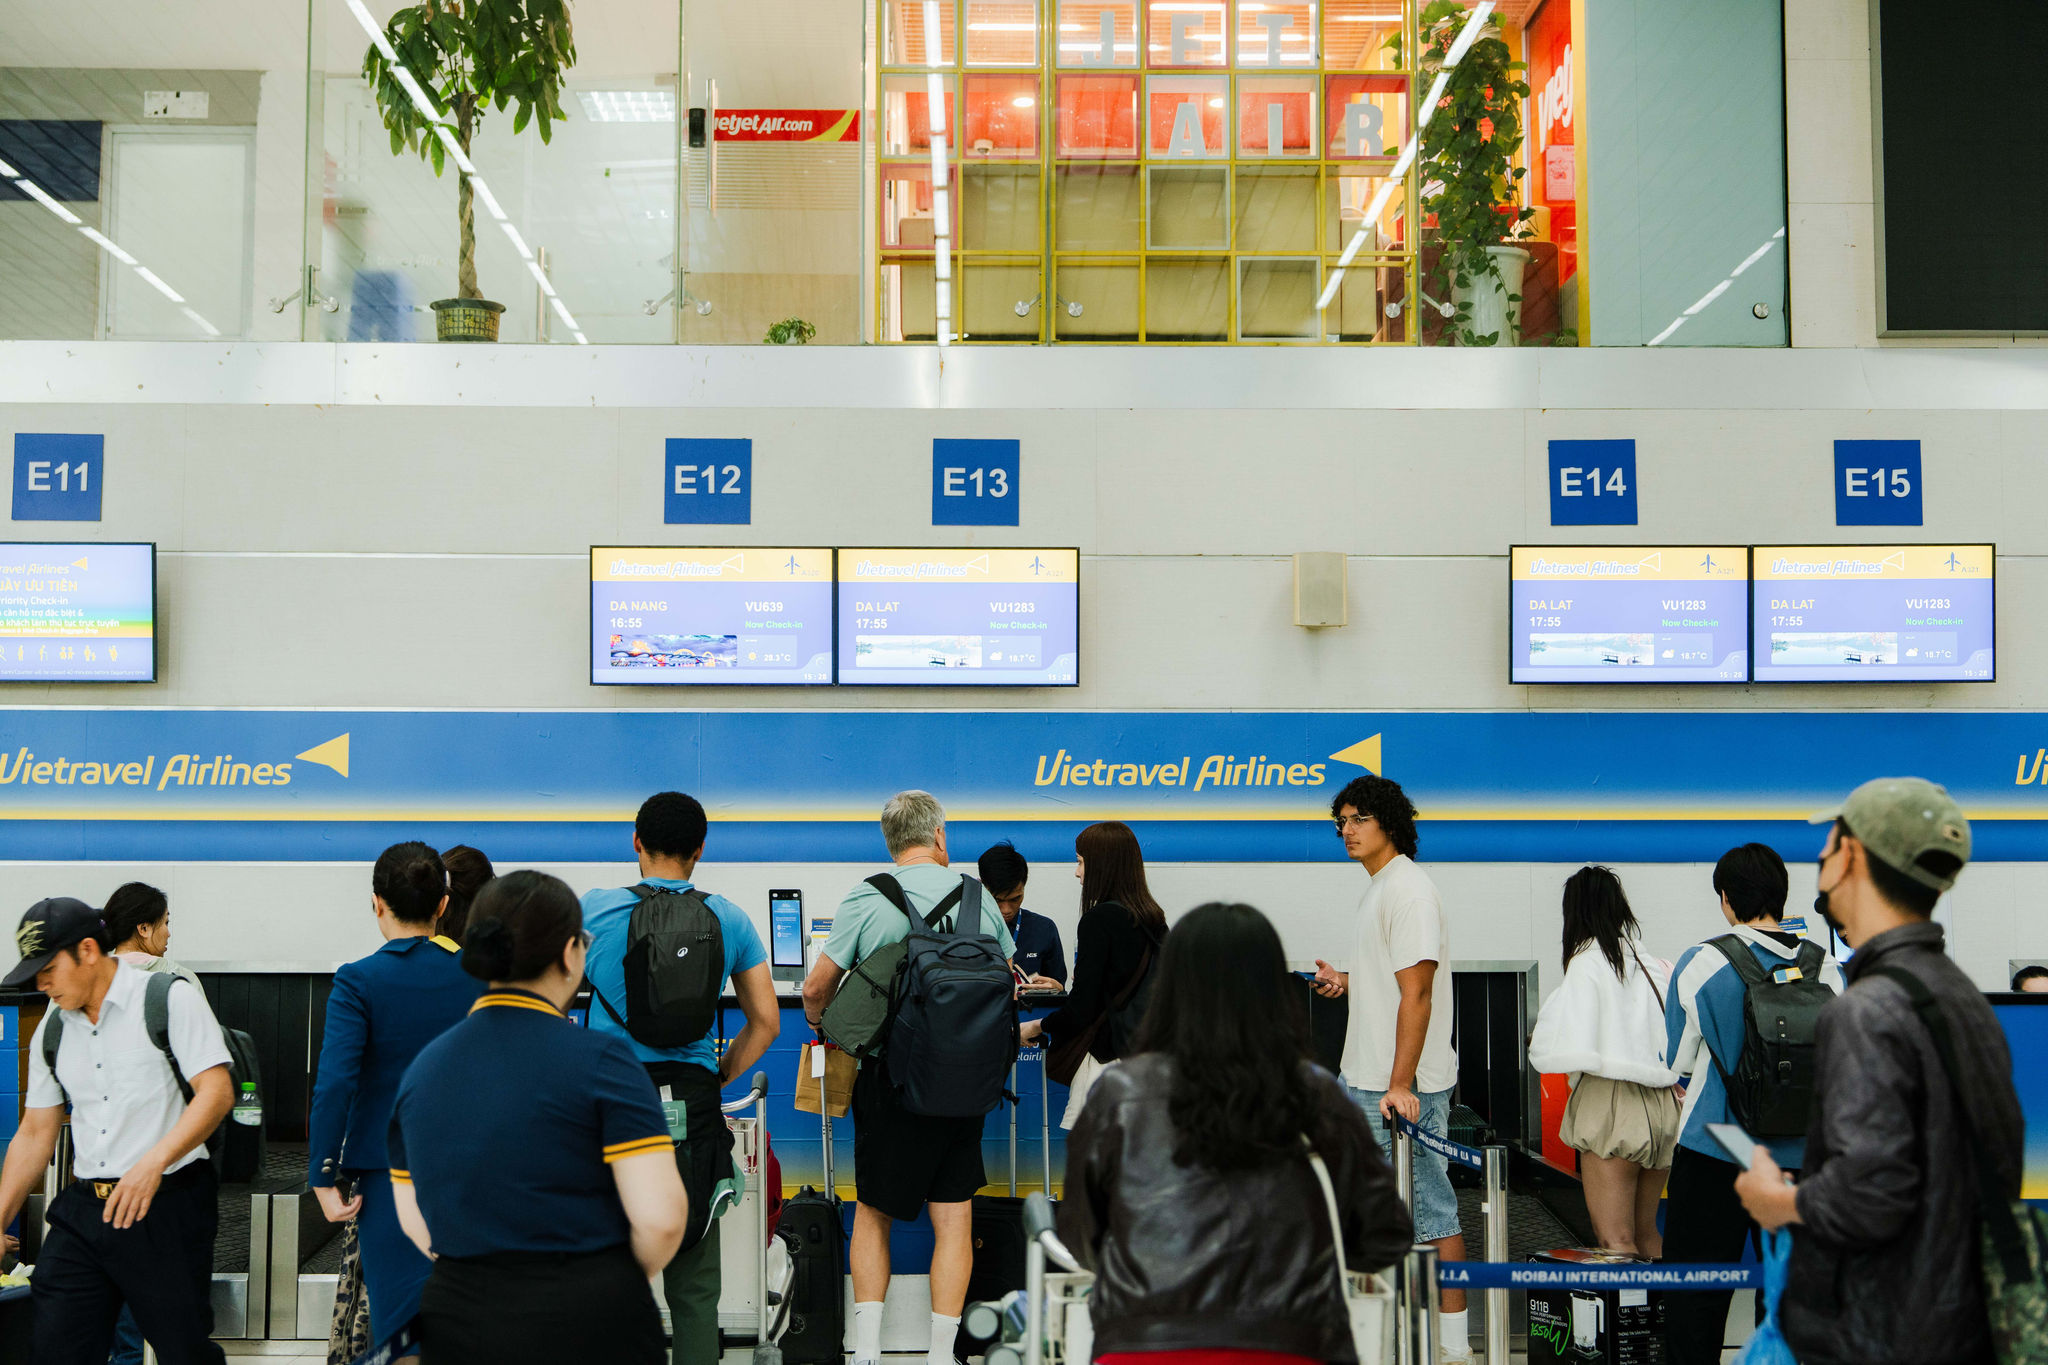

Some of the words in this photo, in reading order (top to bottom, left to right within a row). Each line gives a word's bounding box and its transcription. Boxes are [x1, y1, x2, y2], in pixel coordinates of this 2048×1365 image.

[28, 462, 88, 491] E11
[675, 466, 741, 494] E12
[944, 468, 1009, 497] E13
[1560, 467, 1626, 497] E14
[1846, 468, 1911, 497] E15
[27, 564, 70, 576] Airlines
[610, 558, 669, 576] Vietravel
[670, 561, 721, 579] Airlines
[856, 560, 914, 577] Vietravel
[917, 562, 966, 579] Airlines
[1530, 558, 1588, 575] Vietravel
[1590, 560, 1640, 576] Airlines
[1772, 558, 1830, 574] Vietravel
[1832, 560, 1882, 576] Airlines
[31, 596, 68, 605] Check-in
[1530, 600, 1547, 610] DA
[1550, 600, 1573, 610] LAT
[1662, 600, 1706, 610] VU1283
[1771, 600, 1788, 609] DA
[1792, 600, 1815, 609] LAT
[1906, 599, 1950, 609] VU1283
[610, 601, 627, 611] DA
[631, 601, 668, 611] NANG
[745, 602, 783, 612] VU639
[856, 602, 873, 612] DA
[877, 602, 900, 612] LAT
[990, 603, 1035, 613] VU1283
[610, 618, 642, 628] 16:55
[745, 621, 764, 629] Now
[766, 621, 803, 629] Check-in
[856, 619, 887, 629] 17:55
[1530, 617, 1561, 627] 17:55
[1772, 616, 1803, 626] 17:55
[1906, 618, 1924, 626] Now
[1926, 617, 1963, 626] Check-in
[0, 748, 154, 785] Vietravel
[157, 754, 292, 791] Airlines
[1034, 750, 1190, 786] Vietravel
[1193, 755, 1326, 792] Airlines
[1511, 1271, 1562, 1282] NOIBAI
[1566, 1271, 1681, 1283] INTERNATIONAL
[1684, 1270, 1750, 1282] AIRPORT
[1530, 1299, 1549, 1313] 911B
